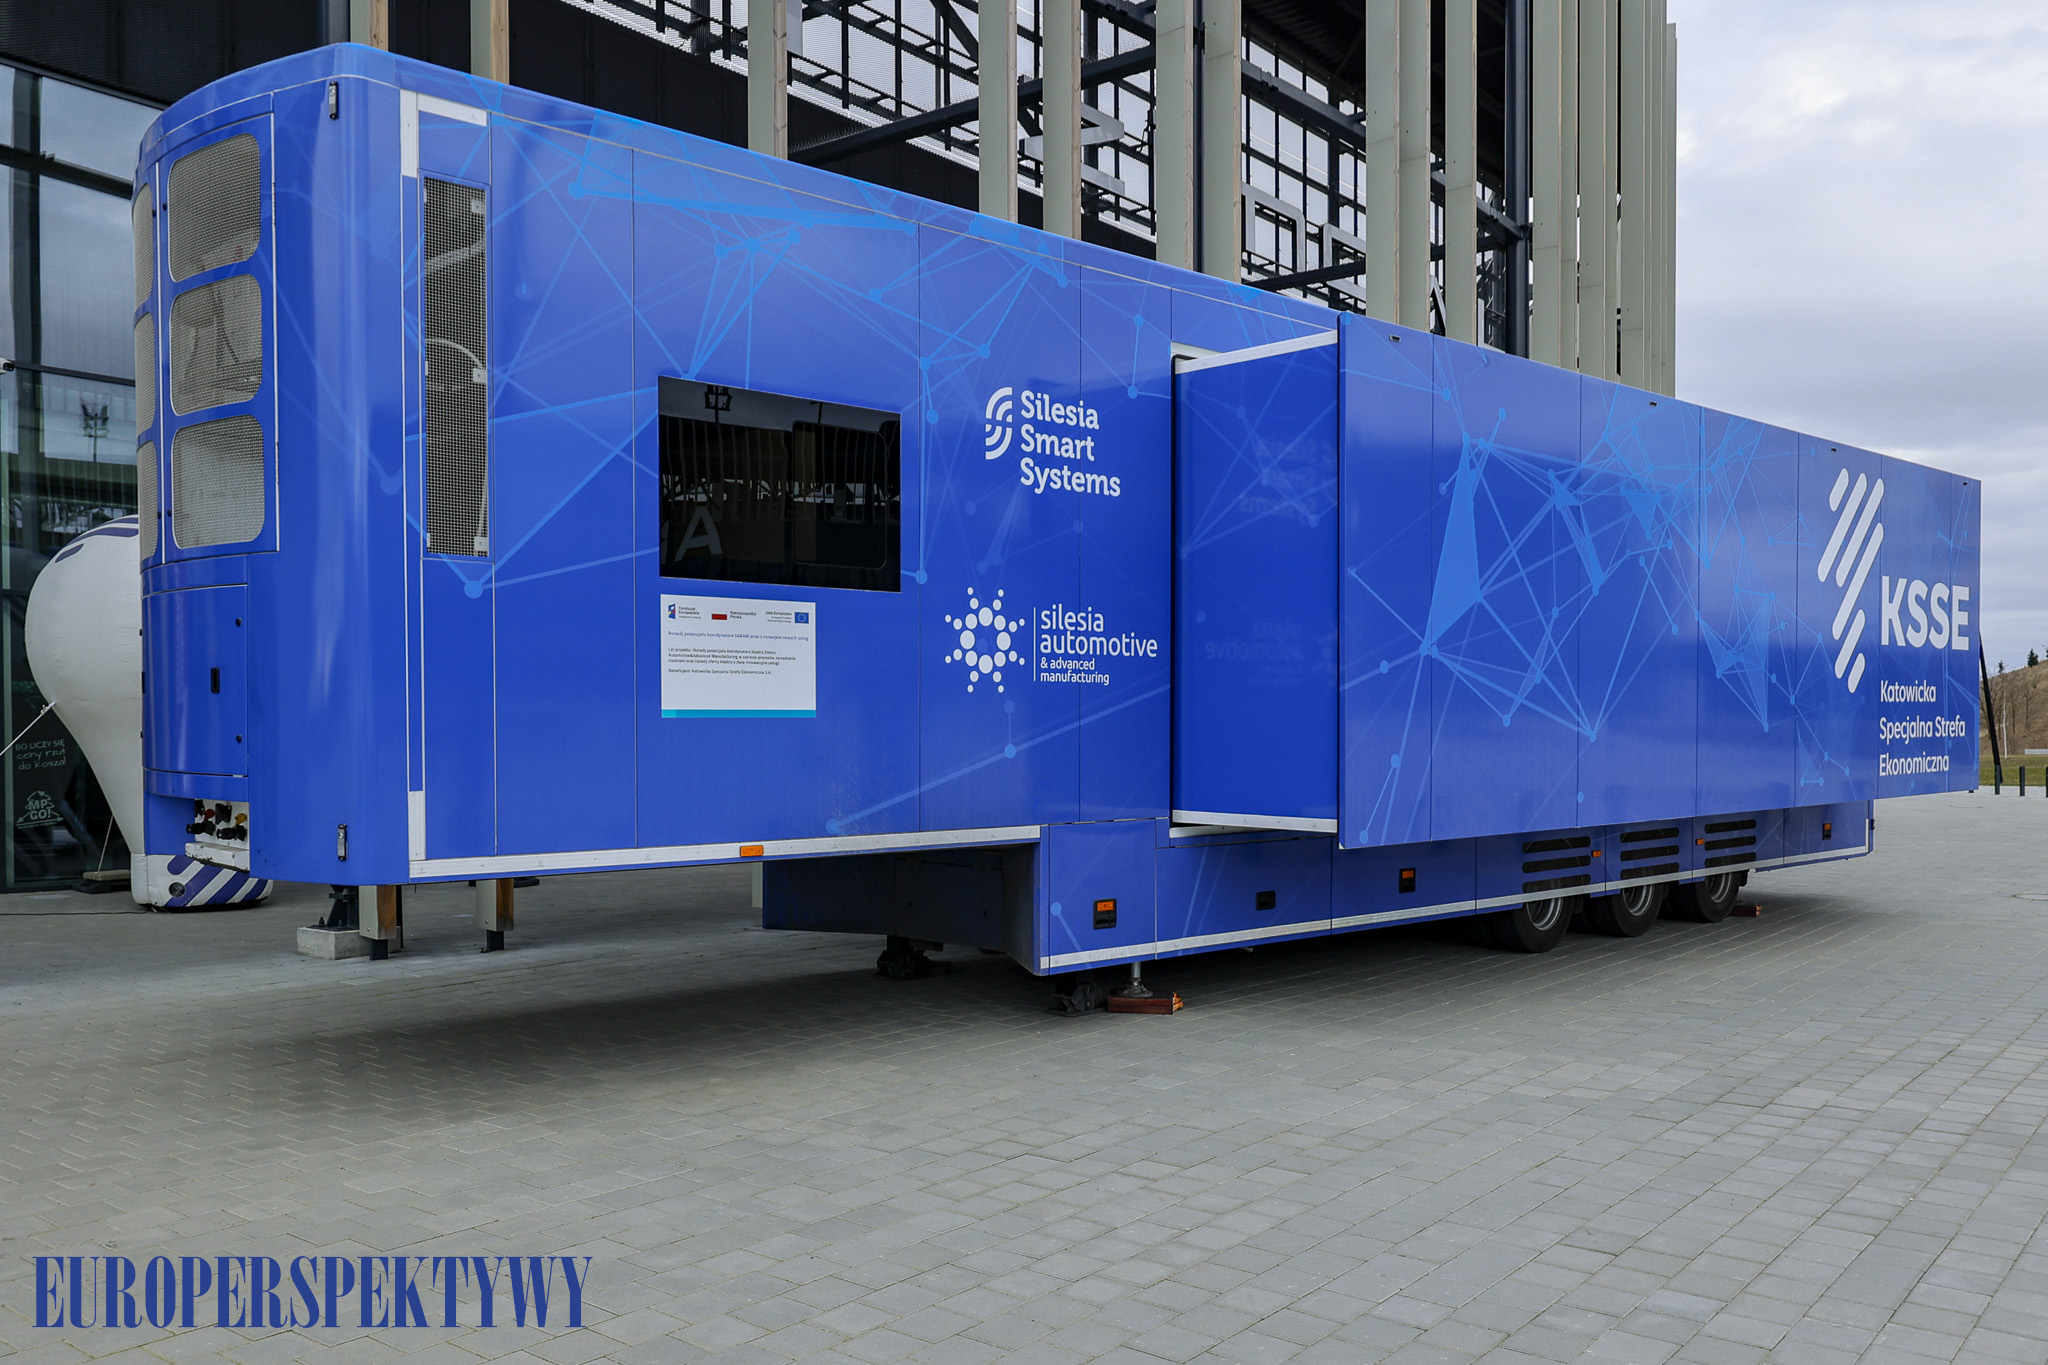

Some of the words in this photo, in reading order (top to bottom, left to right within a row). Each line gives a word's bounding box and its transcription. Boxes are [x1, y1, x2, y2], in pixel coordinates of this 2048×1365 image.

[1020, 389, 1100, 430] Silesia
[1020, 423, 1095, 462] Smart
[1020, 457, 1121, 497] Systems
[1040, 603, 1105, 632] silesia
[1881, 575, 1970, 651] KSSE
[1040, 631, 1158, 657] automotive
[1040, 657, 1049, 669] &
[1050, 658, 1095, 671] advanced
[1040, 669, 1110, 686] manufacturing
[1880, 680, 1937, 702] Katowicka
[1879, 716, 1933, 744] Specjalna
[1935, 714, 1966, 738] Strefa
[18, 760, 32, 771] do
[1879, 752, 1950, 777] Ekonomiczna
